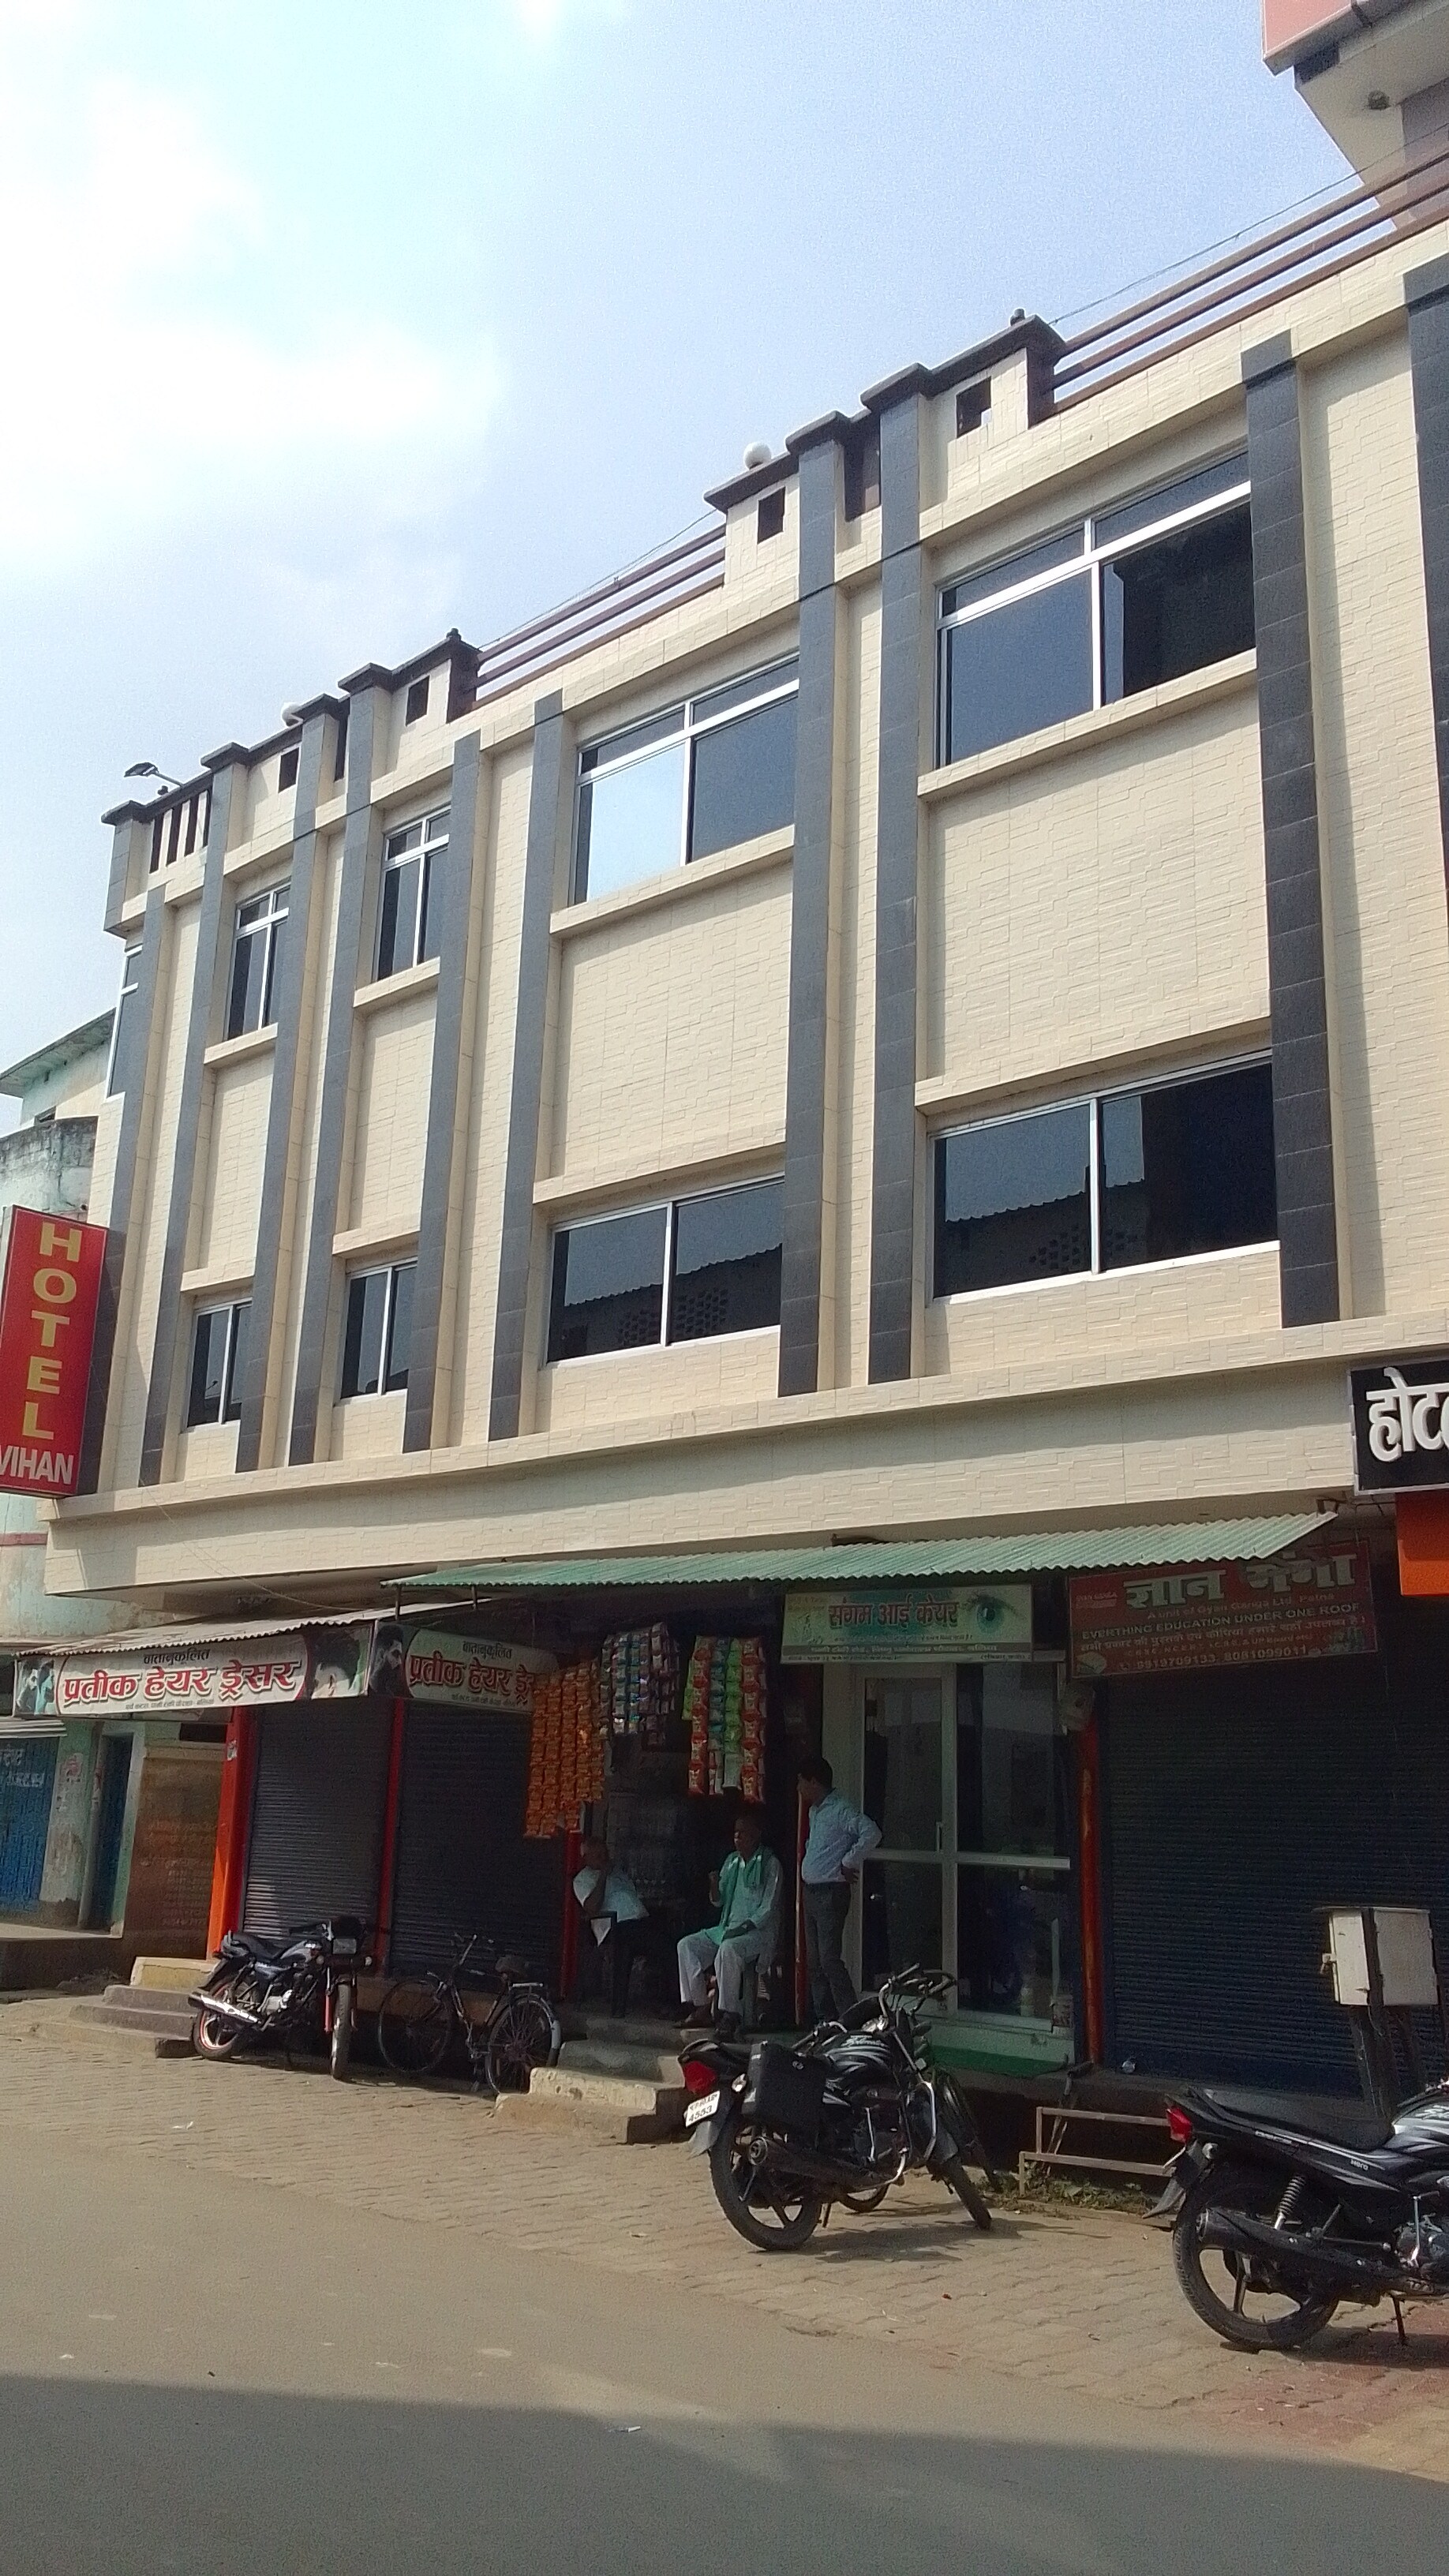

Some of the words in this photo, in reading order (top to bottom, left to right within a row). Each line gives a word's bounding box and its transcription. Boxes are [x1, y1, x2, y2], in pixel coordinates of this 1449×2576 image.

[23, 1222, 83, 1440] HOTEL
[0, 1445, 74, 1485] VIHAN
[828, 1597, 874, 1629] संगम
[879, 1594, 913, 1628] आई
[915, 1594, 960, 1627] केयर
[1156, 1616, 1230, 1632] EDUCATION
[1234, 1611, 1283, 1623] UNDER
[1286, 1607, 1316, 1618] ONE
[1320, 1602, 1359, 1616] ROOF
[144, 1648, 210, 1665] वातानुकूलित
[410, 1649, 467, 1687] प्रतीक
[469, 1657, 513, 1695] हेयर
[63, 1668, 142, 1707] प्रतीक
[144, 1665, 219, 1702] हेयर
[219, 1660, 302, 1701] ड्रेसर
